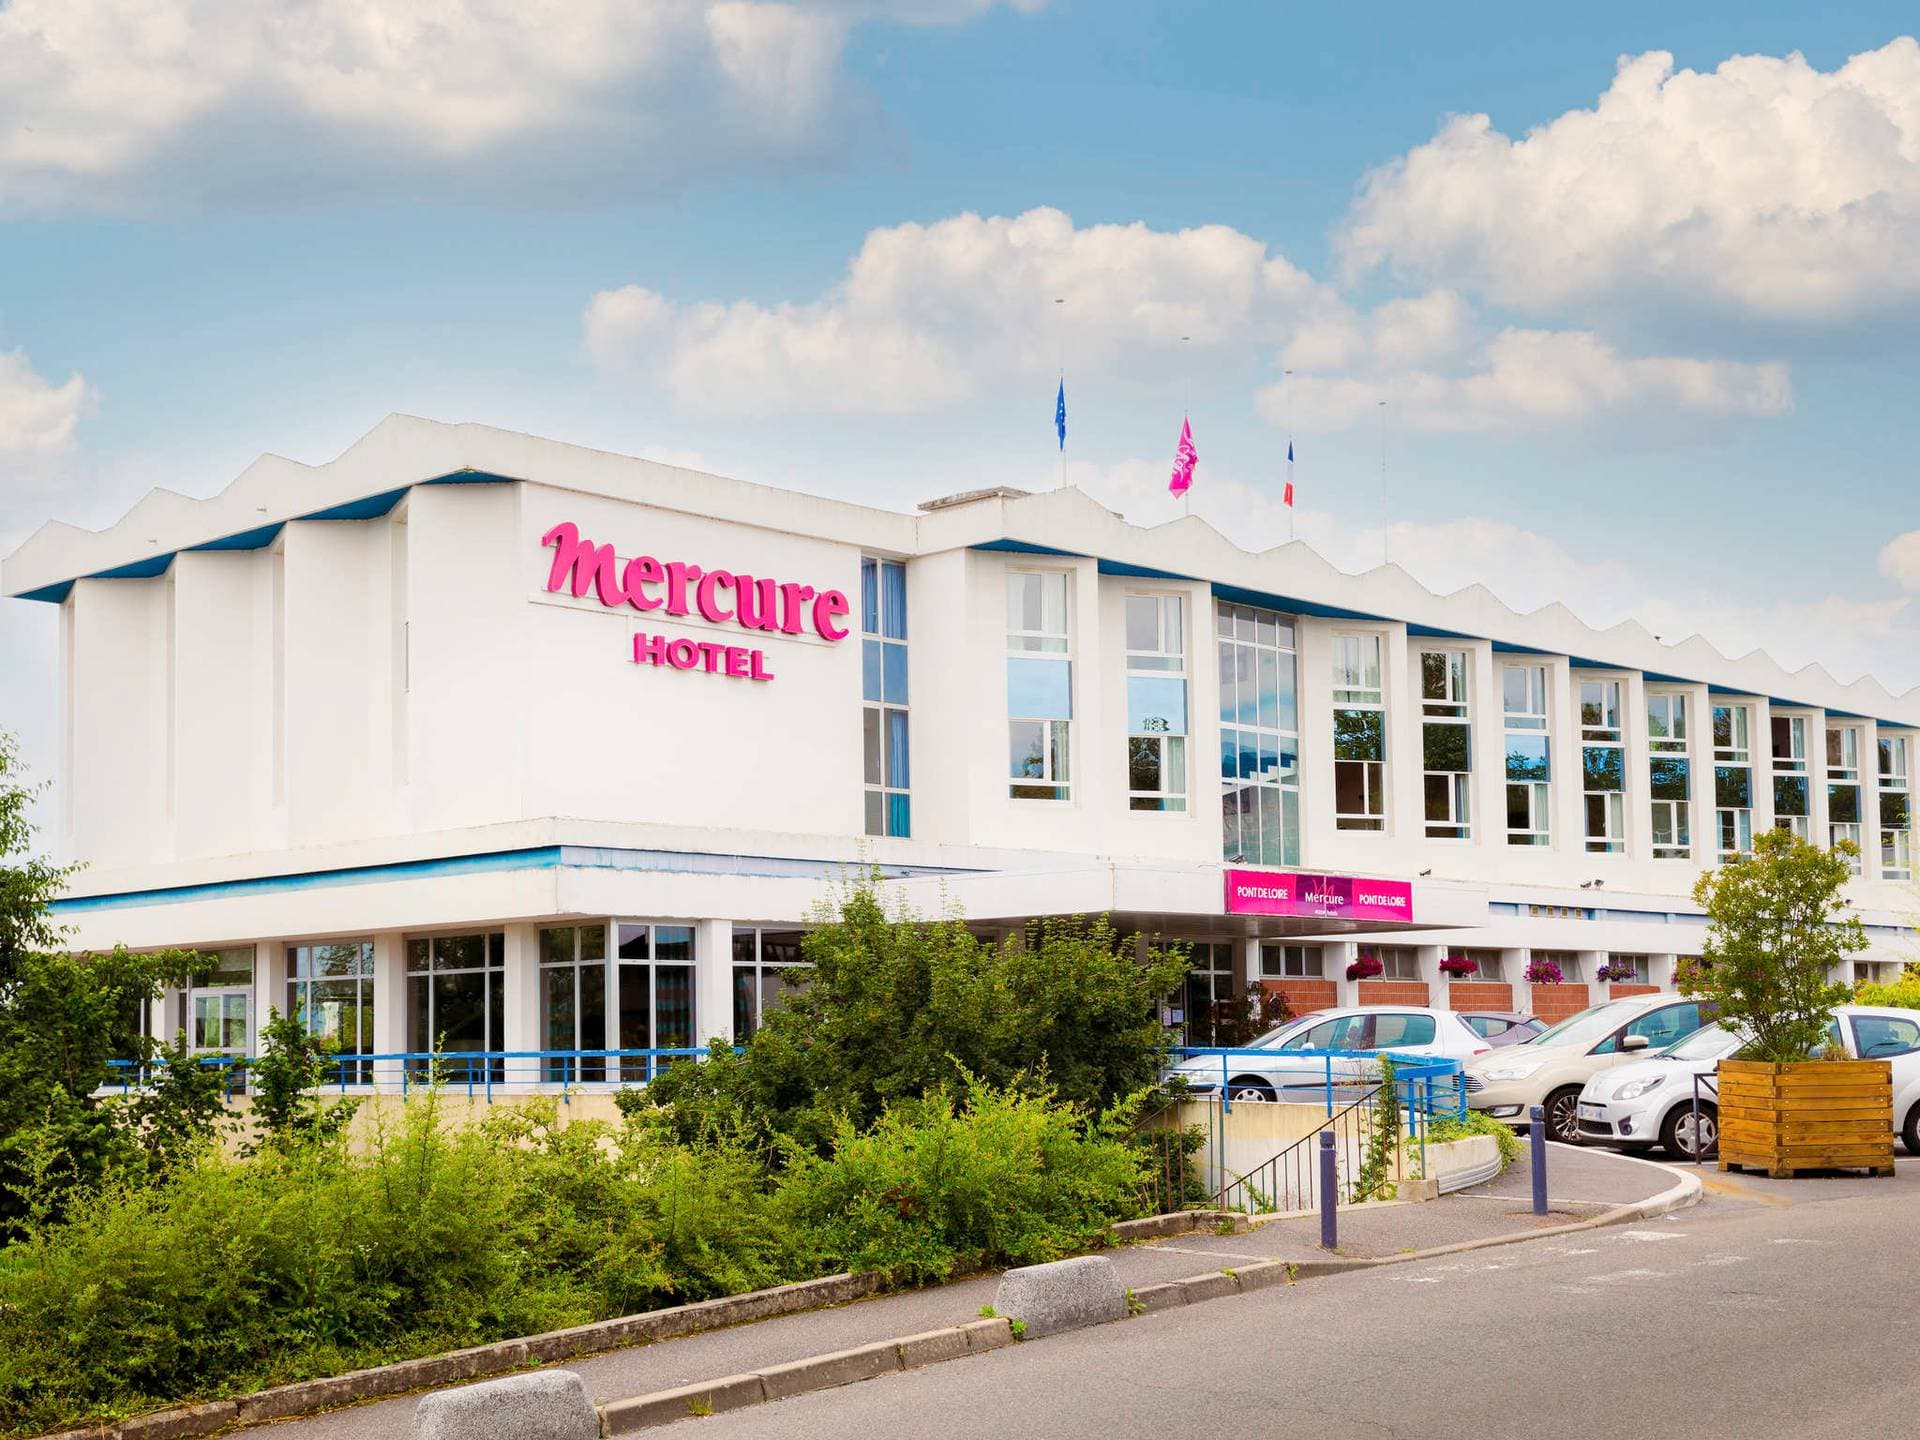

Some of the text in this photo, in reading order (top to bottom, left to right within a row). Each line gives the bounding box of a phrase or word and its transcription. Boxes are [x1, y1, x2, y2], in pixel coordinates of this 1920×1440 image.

[541, 522, 850, 642] Mercure
[633, 632, 775, 681] HOTEL
[1237, 886, 1288, 900] PONT DE LOIRE
[1305, 892, 1344, 905] Mercure
[1359, 894, 1406, 907] PONT DE LOIRE
